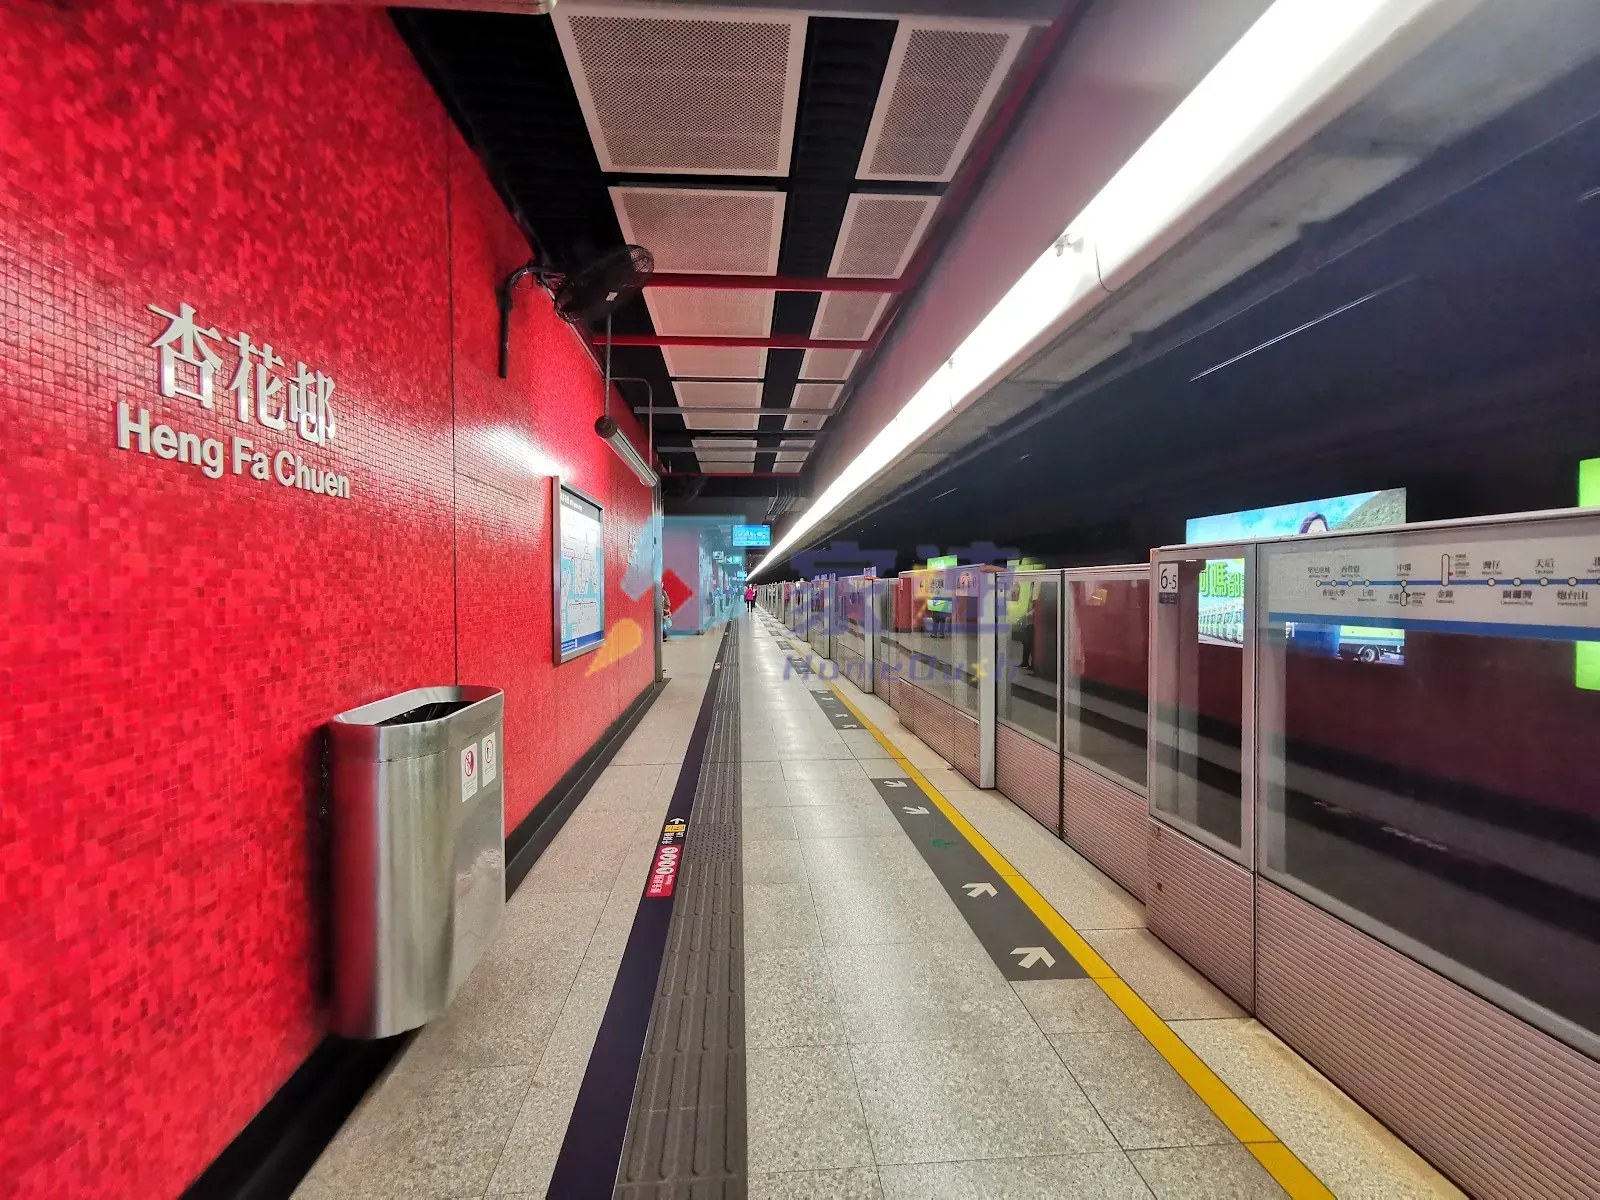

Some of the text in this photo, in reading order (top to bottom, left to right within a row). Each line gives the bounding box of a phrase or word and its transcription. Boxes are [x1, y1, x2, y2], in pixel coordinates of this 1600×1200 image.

[146, 302, 336, 446] 杏花邨
[117, 400, 350, 498] Heng Fa Chuen
[1160, 568, 1177, 589] 6-5
[1557, 589, 1588, 600] 炮台山
